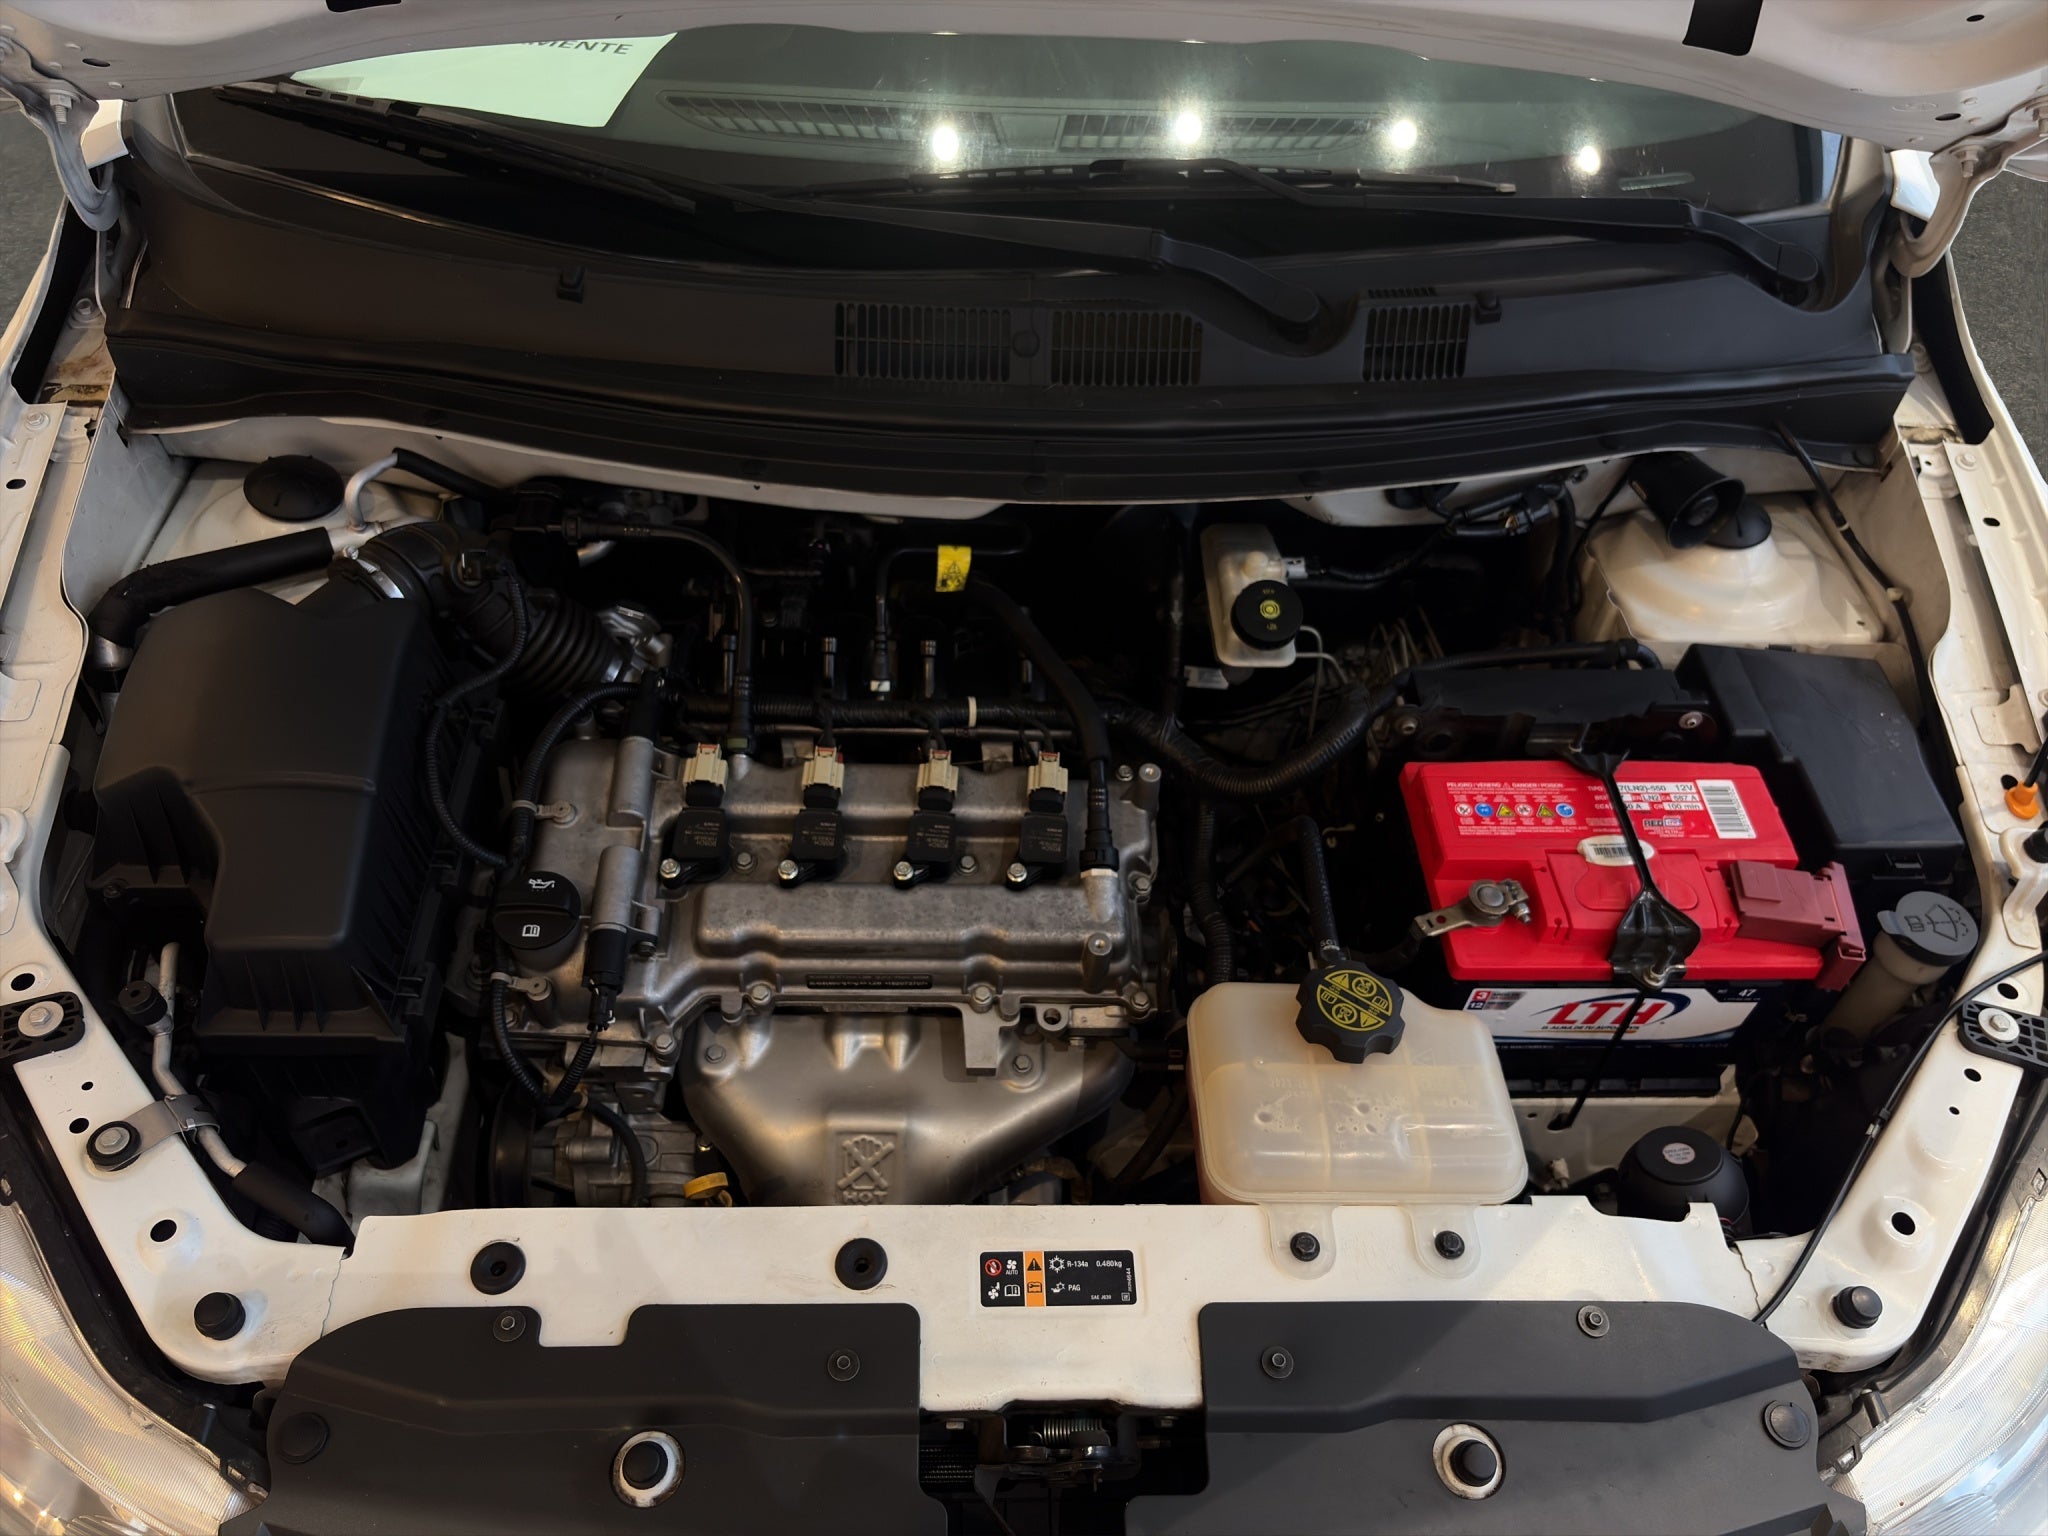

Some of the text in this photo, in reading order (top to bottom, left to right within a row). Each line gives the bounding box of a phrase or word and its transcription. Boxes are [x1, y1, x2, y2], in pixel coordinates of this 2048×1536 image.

[1618, 784, 1667, 792] 7(LN2)-550
[1477, 991, 1488, 1000] 3
[1738, 988, 1757, 997] 47
[1547, 1002, 1667, 1025] LTH
[843, 1190, 888, 1205] HOT
[1066, 1260, 1089, 1268] R-134a
[1068, 1284, 1081, 1292] PAG
